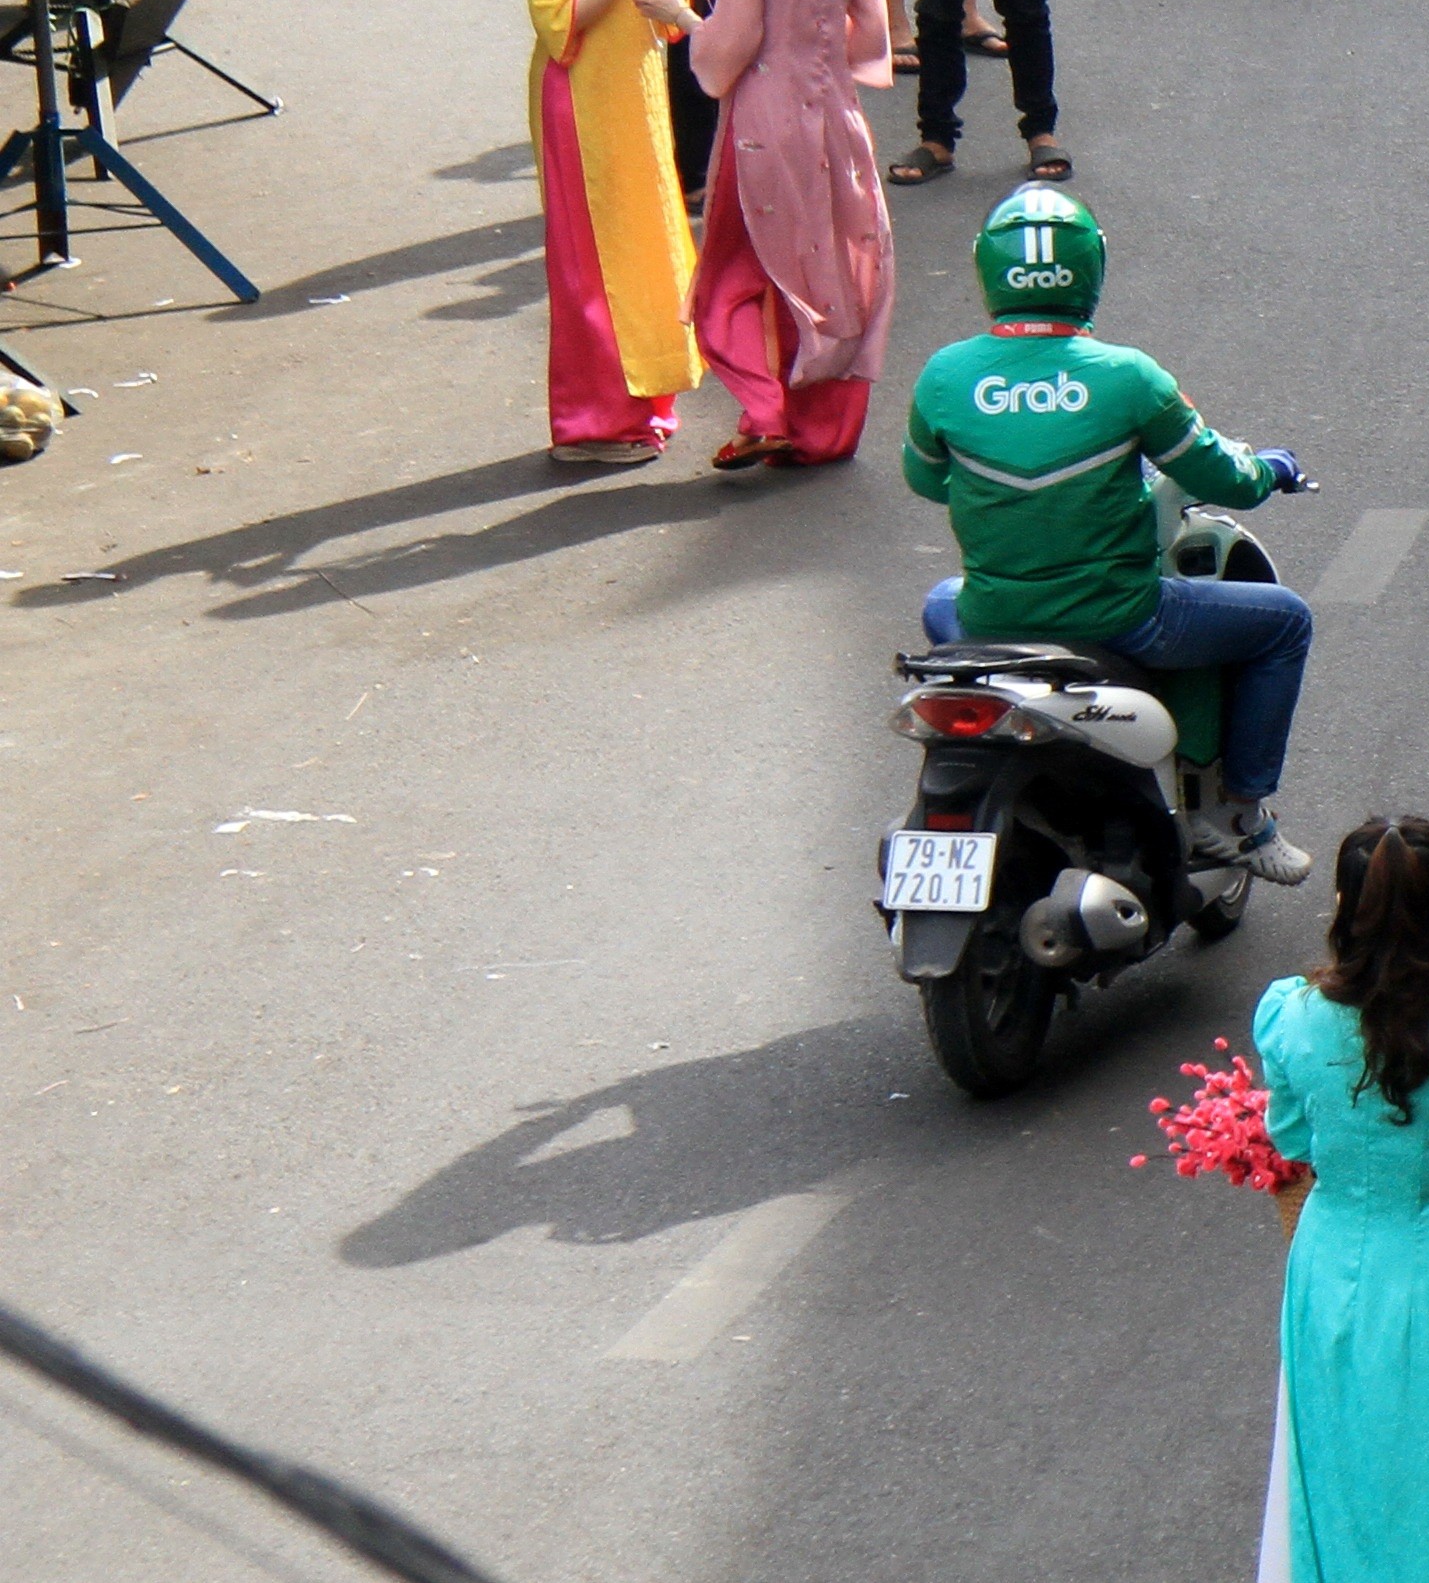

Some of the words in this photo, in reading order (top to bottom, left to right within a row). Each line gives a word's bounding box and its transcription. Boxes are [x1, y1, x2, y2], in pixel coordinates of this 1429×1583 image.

[1007, 264, 1073, 289] Grab
[1024, 323, 1053, 334] PUMA
[974, 371, 1089, 415] Grab
[906, 838, 978, 870] 79-N2
[891, 872, 982, 905] 720.11
